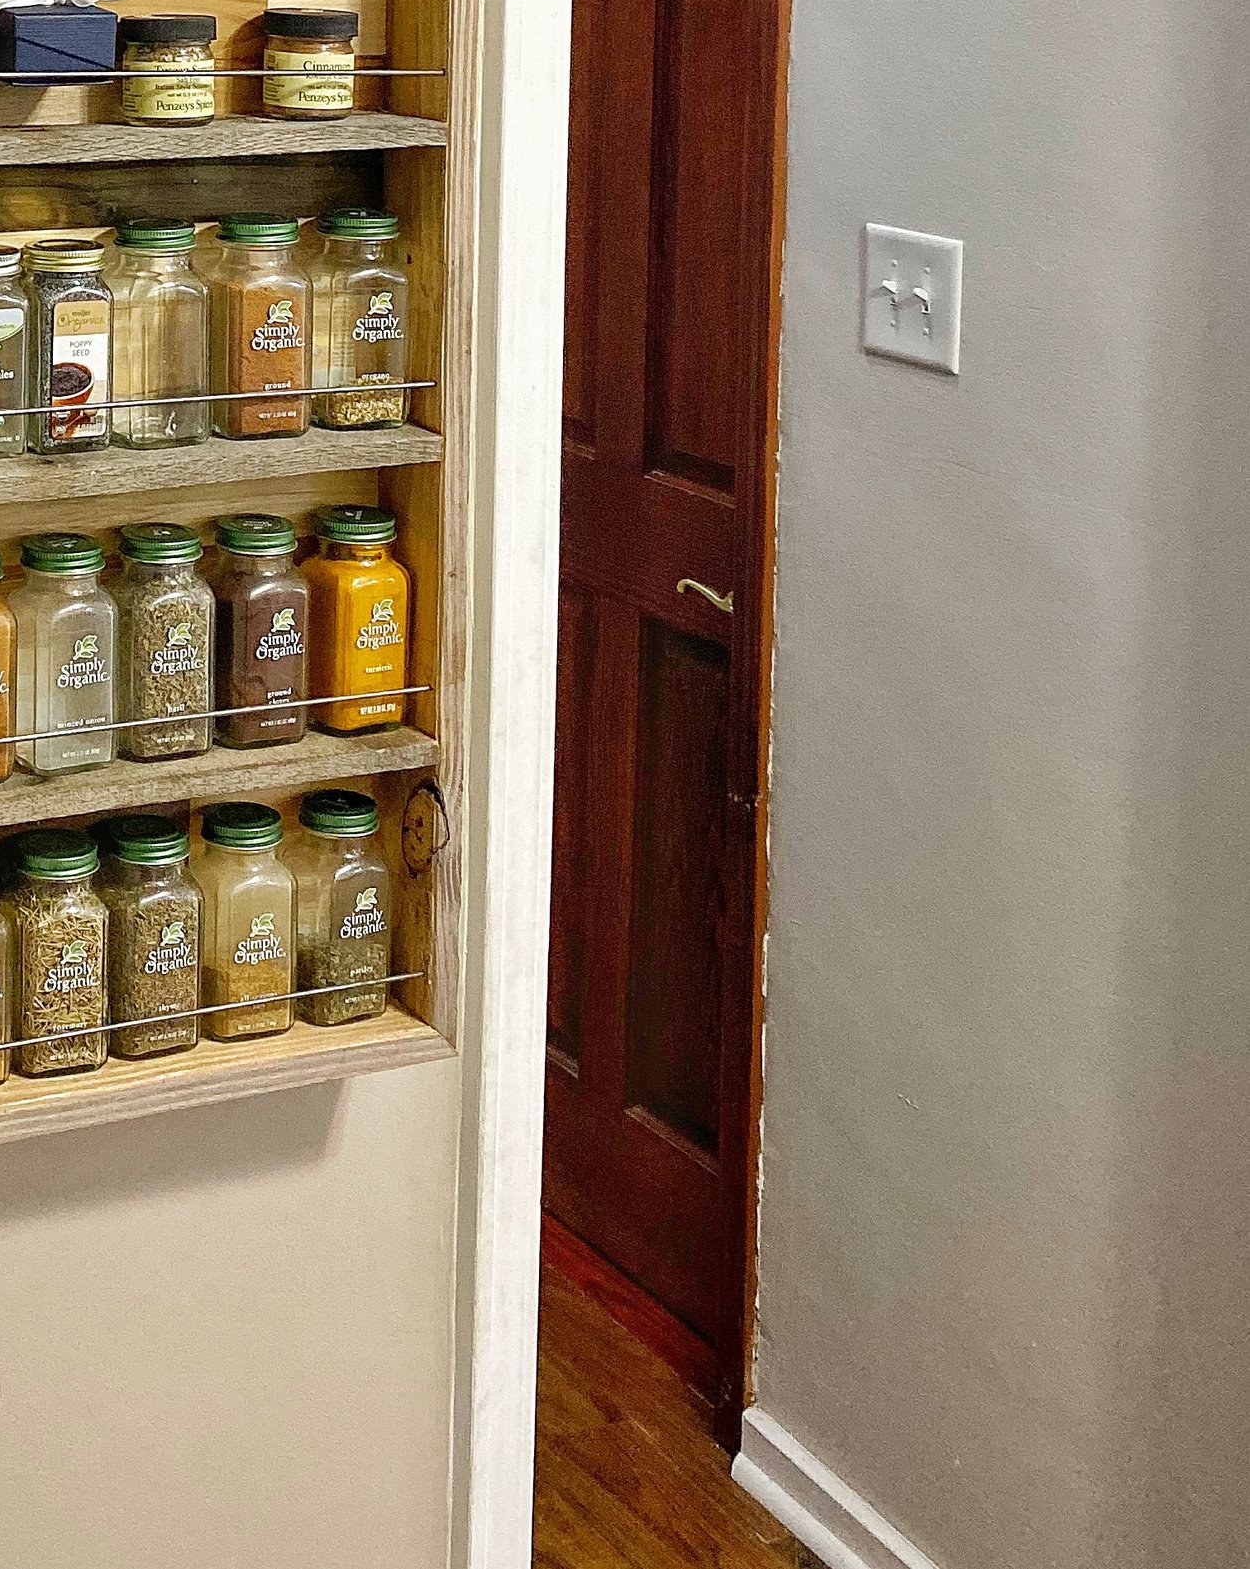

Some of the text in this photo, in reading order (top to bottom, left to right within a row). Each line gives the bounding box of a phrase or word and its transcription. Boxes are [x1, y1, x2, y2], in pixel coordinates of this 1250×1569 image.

[303, 60, 351, 71] Cinnamon
[299, 91, 336, 105] Penzeys
[156, 101, 195, 113] Penzeys
[356, 314, 400, 330] Simply
[255, 322, 300, 340] Simply
[70, 340, 93, 349] POPPY
[71, 349, 90, 358] SEED
[264, 380, 291, 391] ground
[360, 620, 399, 637] Simply
[260, 630, 302, 649] Simply
[154, 645, 198, 664] Simply
[61, 657, 106, 676] Simply
[365, 663, 393, 673] turmeric
[267, 687, 292, 699] ground
[167, 703, 185, 713] basil
[57, 716, 106, 729] minced onion
[343, 908, 383, 928] Simply
[238, 934, 281, 954] Simply
[148, 943, 191, 962] Simply
[48, 962, 94, 981] Simply
[350, 965, 373, 977] parsley
[53, 1022, 88, 1032] rosemary
